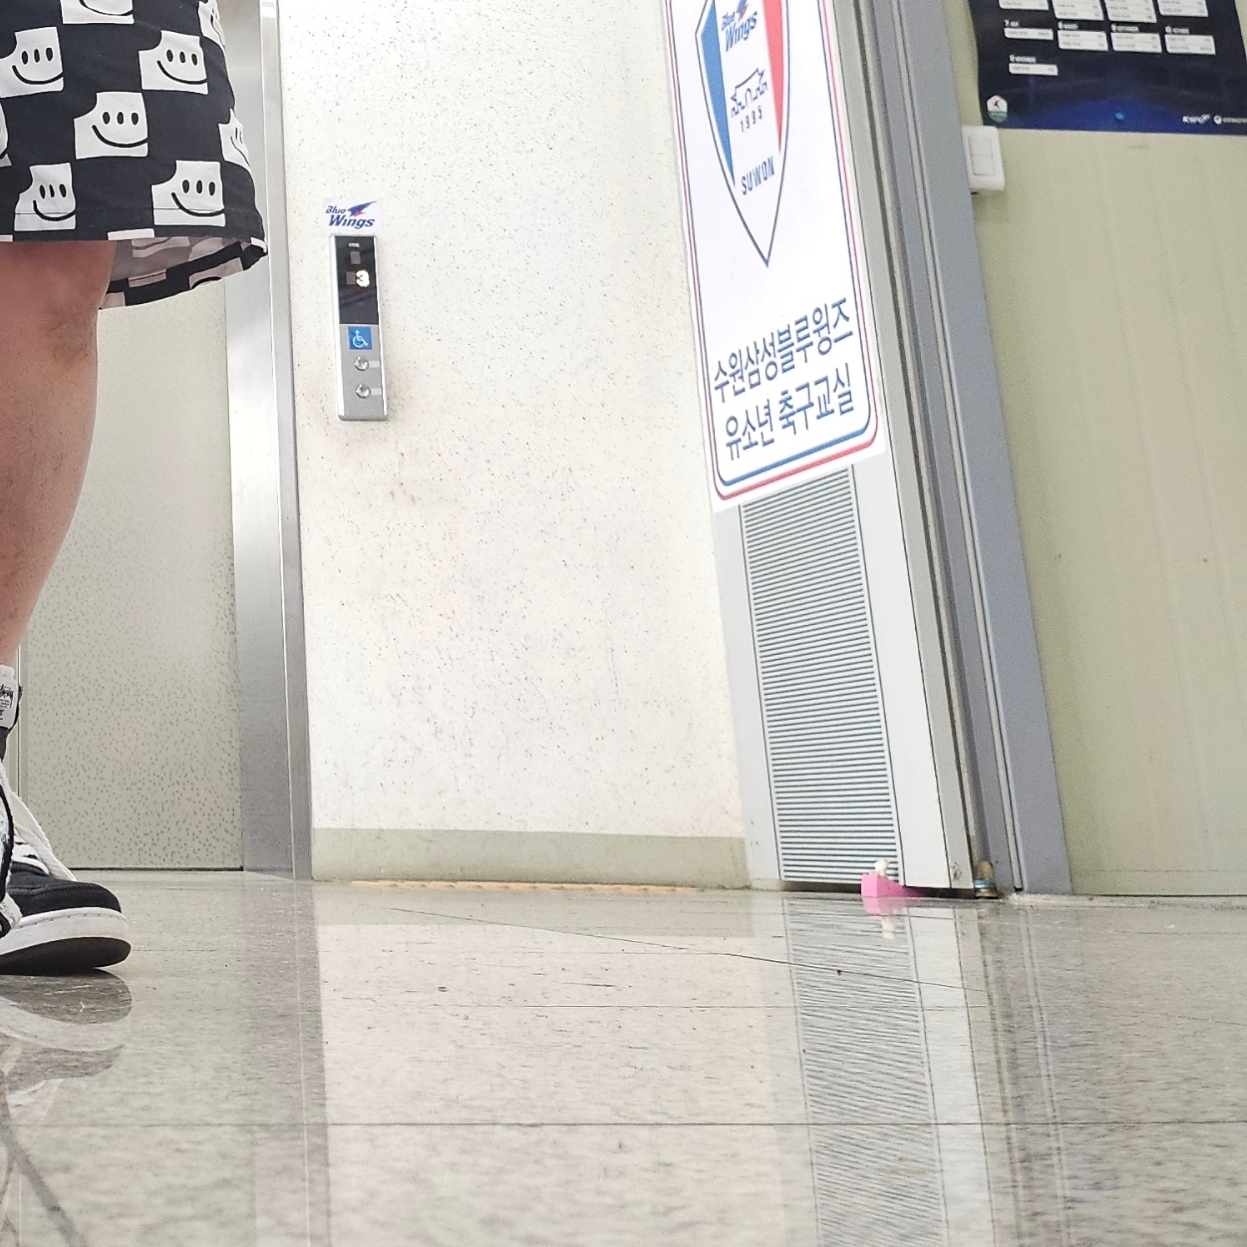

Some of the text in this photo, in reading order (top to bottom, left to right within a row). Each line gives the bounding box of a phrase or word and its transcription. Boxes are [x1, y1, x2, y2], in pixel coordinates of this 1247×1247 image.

[726, 11, 758, 52] Wings
[740, 105, 763, 133] 1995
[741, 155, 775, 195] SUWON
[328, 214, 376, 230] Wings
[714, 297, 854, 403] 수원삼성블루윙즈
[725, 362, 854, 461] 유소년 축구교실
